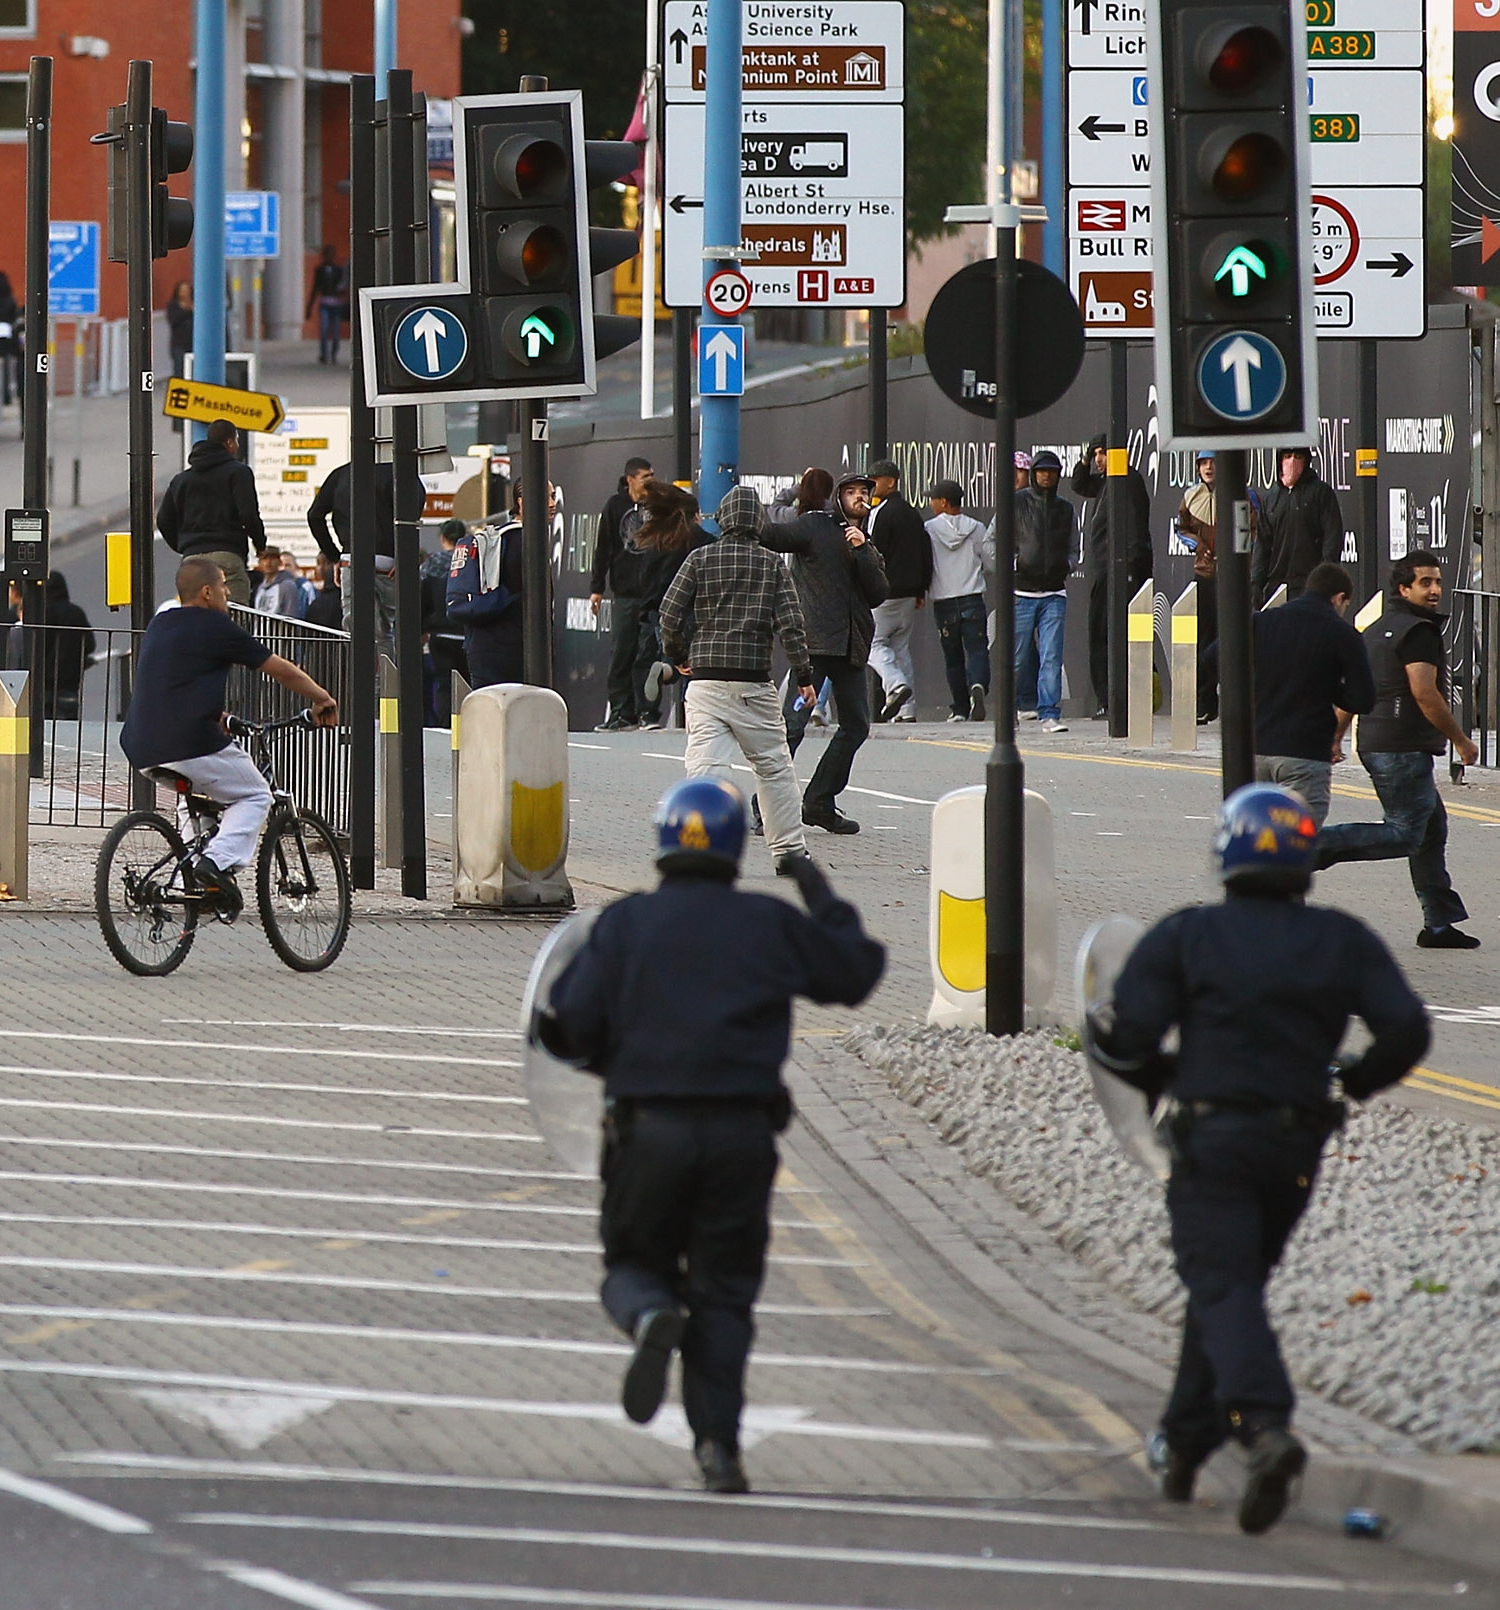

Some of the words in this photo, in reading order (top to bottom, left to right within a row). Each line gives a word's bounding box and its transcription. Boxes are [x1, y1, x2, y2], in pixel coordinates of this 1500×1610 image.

[748, 4, 834, 20] University
[747, 23, 814, 37] Science
[820, 23, 858, 37] Park
[1105, 36, 1147, 55] Lich
[742, 51, 796, 66] nktank
[802, 52, 819, 66] at
[795, 69, 839, 84] Point
[744, 110, 767, 123] rts
[764, 157, 777, 171] D
[745, 184, 799, 197] Albert
[805, 184, 825, 197] St
[745, 201, 852, 217] Londonderry
[859, 201, 895, 215] Hse.
[1079, 238, 1124, 256] Bull
[713, 284, 746, 303] 20
[838, 281, 871, 292] A&E
[40, 355, 48, 371] 9
[193, 396, 263, 418] Masshouse
[536, 420, 547, 439] 7
[1423, 418, 1443, 453] SUITE
